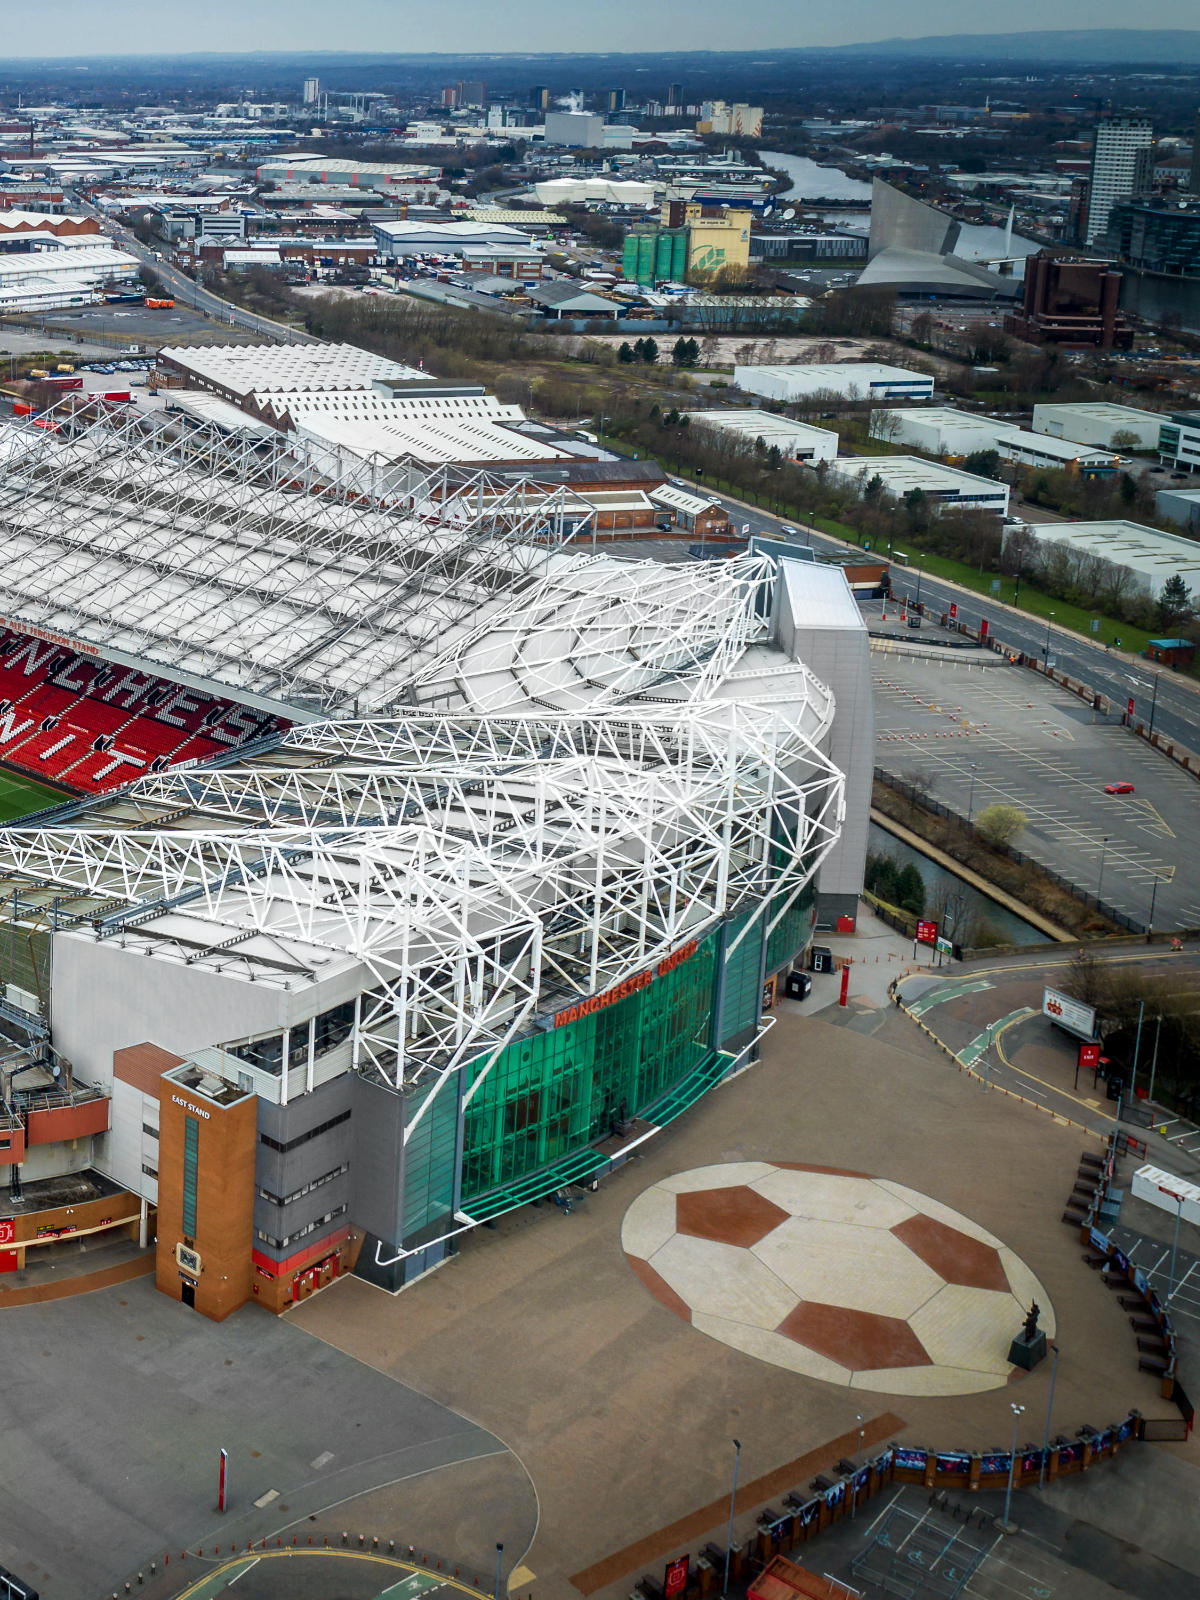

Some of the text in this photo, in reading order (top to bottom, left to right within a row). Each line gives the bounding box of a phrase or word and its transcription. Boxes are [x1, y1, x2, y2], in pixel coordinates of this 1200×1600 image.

[8, 620, 28, 633] ALEX
[29, 626, 70, 646] FERGUSON
[71, 640, 100, 655] STAND
[553, 939, 698, 1029] MANCHESTER UNITED
[171, 1094, 211, 1120] EAST STAND
